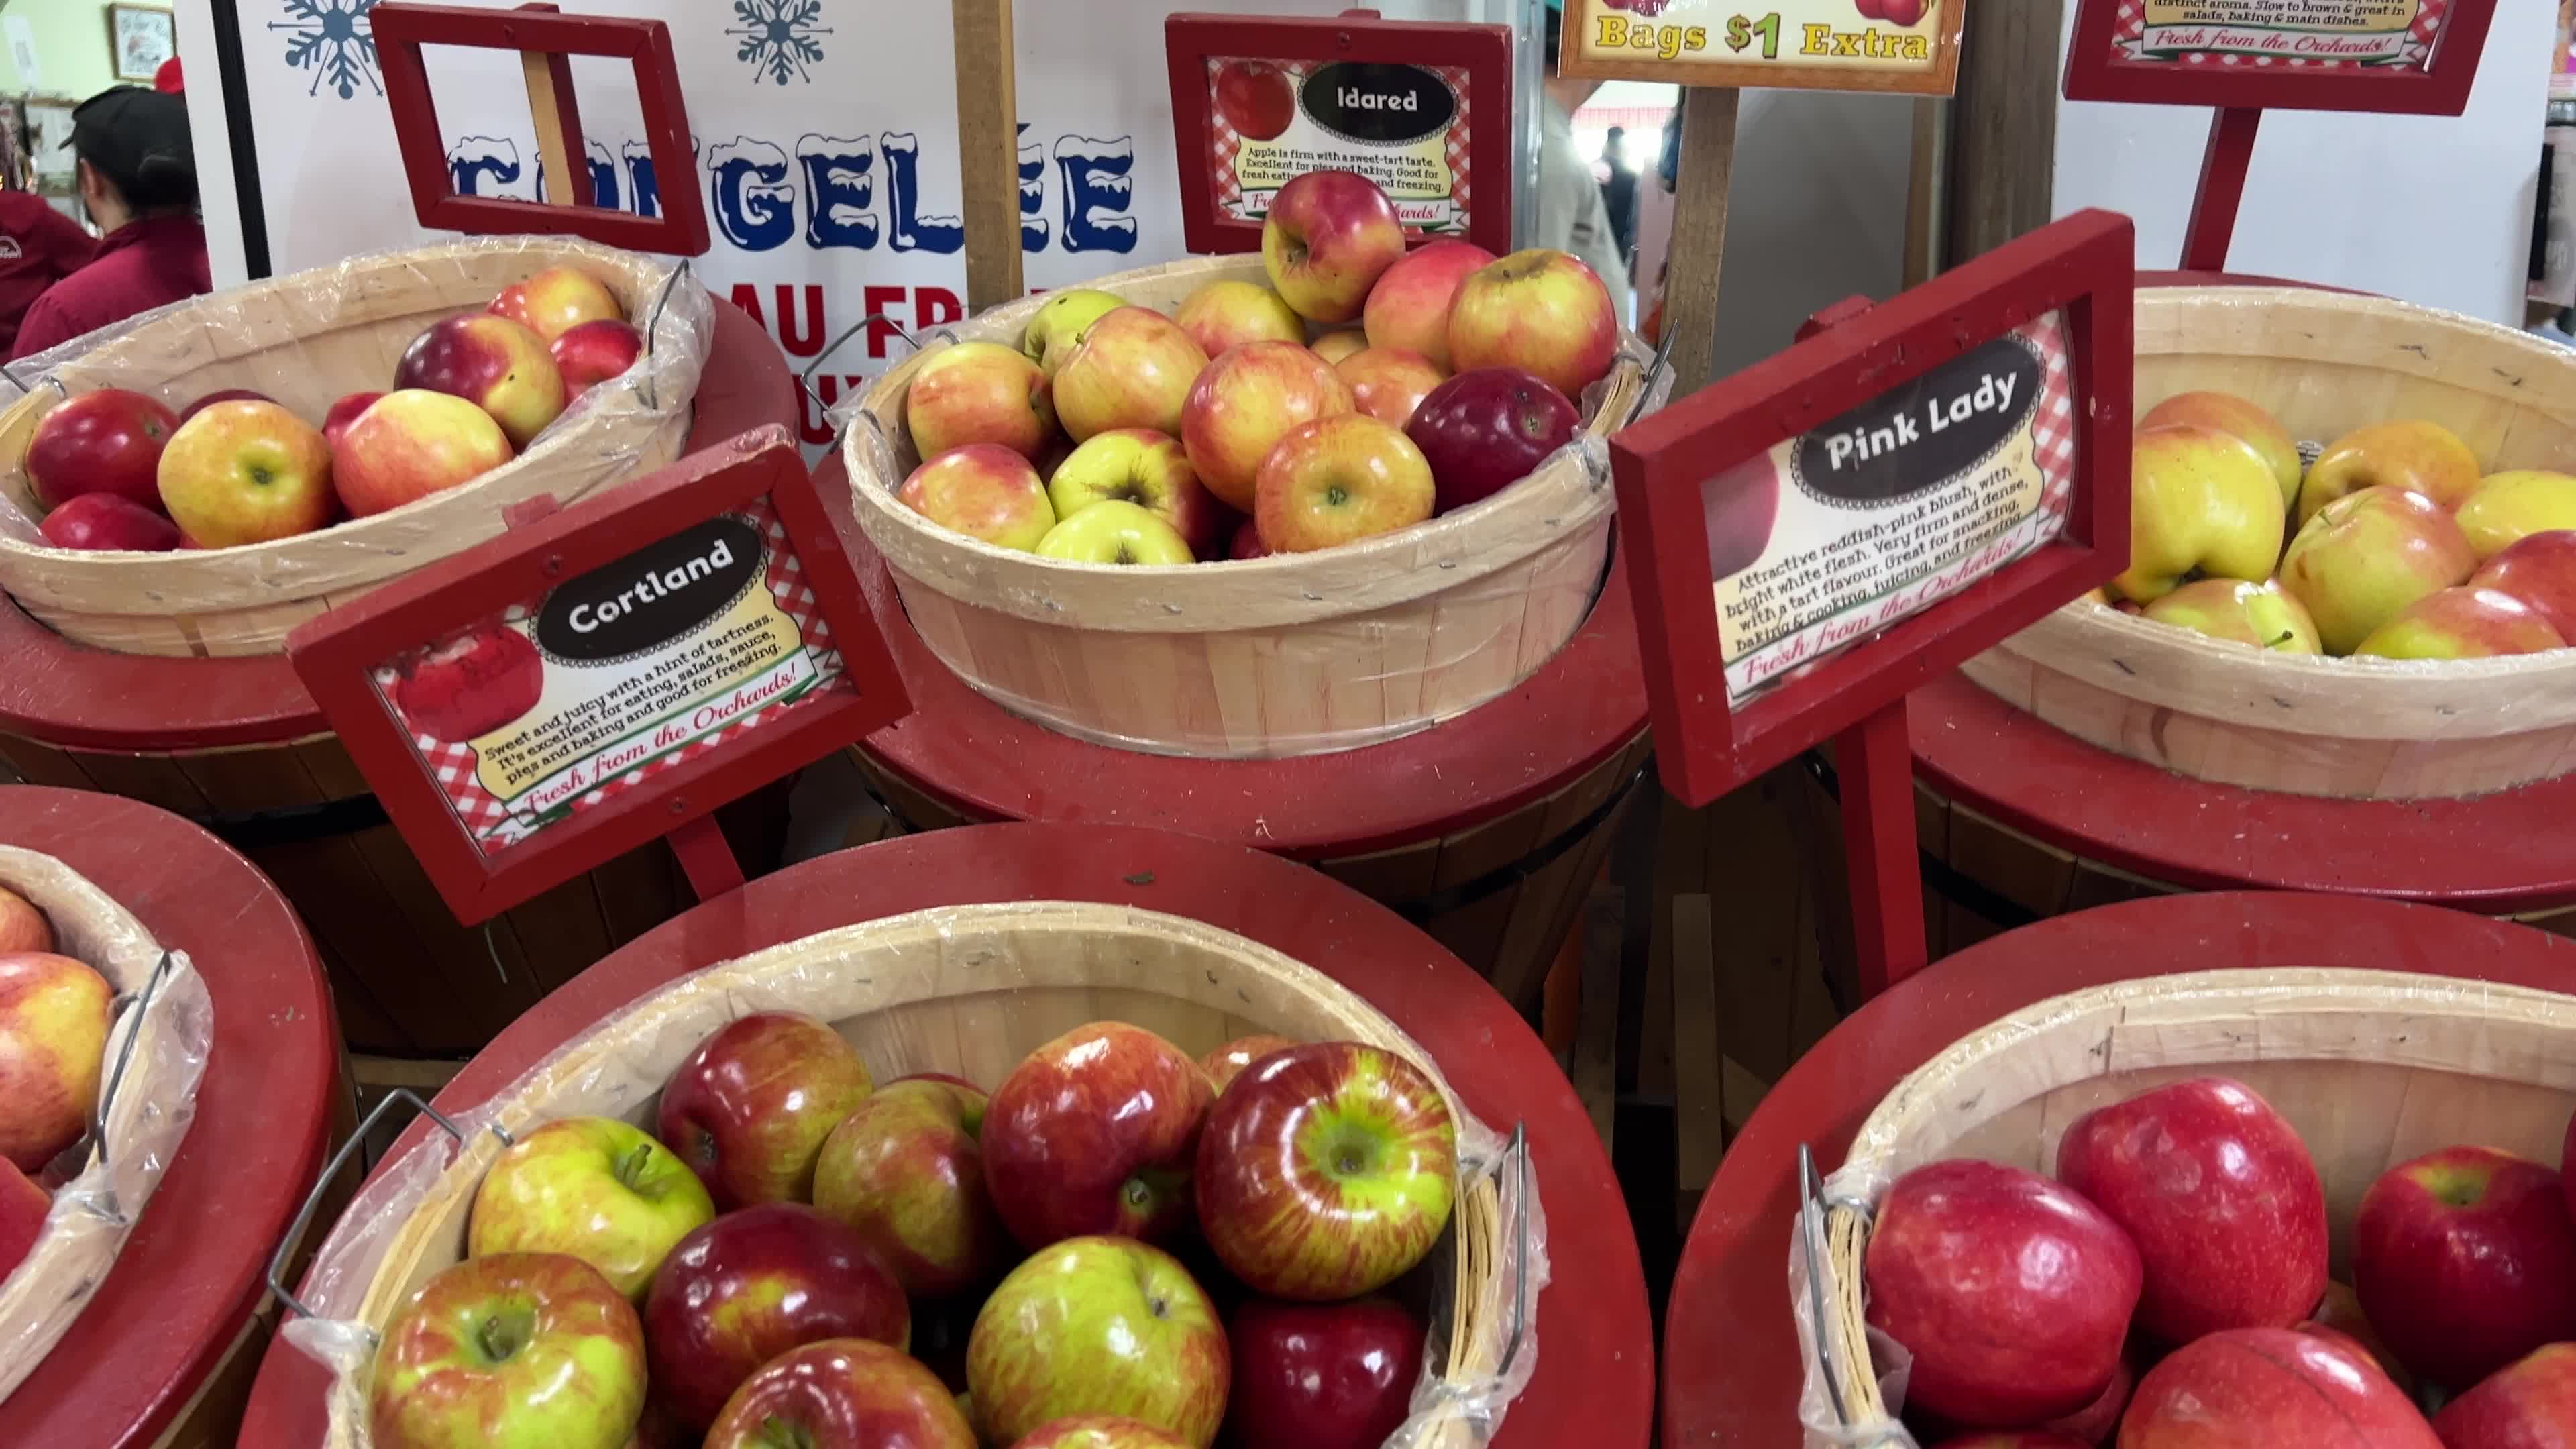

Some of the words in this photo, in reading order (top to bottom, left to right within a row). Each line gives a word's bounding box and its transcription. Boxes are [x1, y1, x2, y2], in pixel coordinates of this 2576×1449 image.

[1595, 15, 1707, 60] Bags
[1725, 13, 1781, 59] $1
[1799, 23, 1928, 60] Extra
[2155, 28, 2205, 46] Fresh
[2203, 29, 2255, 49] from
[2261, 33, 2288, 49] the
[2294, 36, 2392, 52] Orchards!
[2183, 10, 2224, 23] salads,
[2229, 11, 2273, 24] baking
[2274, 13, 2283, 22] &
[2286, 14, 2320, 24] main
[2323, 15, 2369, 26] dishes.
[2210, 0, 2252, 9] aroma.
[2255, 1, 2285, 11] Slow
[2288, 2, 2299, 11] to
[2302, 2, 2341, 13] brown
[2343, 5, 2351, 13] &
[2355, 6, 2388, 16] great
[2391, 7, 2406, 16] in
[1337, 86, 1417, 111] Idared
[1242, 169, 1270, 180] fresh
[1271, 171, 1297, 181] eati
[1397, 180, 1444, 193] freezing.
[1246, 158, 1293, 169] Excellent
[1296, 161, 1309, 172] for
[1397, 168, 1421, 178] Good
[1425, 170, 1438, 179] for
[1248, 147, 1275, 158] Apple
[1279, 148, 1288, 158] is
[1291, 149, 1314, 160] firm
[1317, 152, 1340, 161] with
[1350, 154, 1403, 165] sweet-tart
[1406, 156, 1436, 167] taste.
[1825, 412, 1919, 470] Pink
[1929, 371, 2017, 433] Lady
[1725, 586, 1776, 619] bright
[1778, 570, 1821, 595] white
[1825, 550, 1871, 572] flesh.
[1874, 532, 1911, 553] Very
[1915, 515, 1949, 538] firm
[1952, 503, 1979, 521] and
[1739, 550, 1817, 594] Attractive
[1821, 504, 1927, 557] reddish-pink
[1929, 486, 1976, 513] blush,
[1979, 466, 2012, 490] with
[568, 539, 735, 633] Cortland
[1736, 623, 1790, 653] baking
[1793, 615, 1805, 629] &
[1934, 545, 1960, 564] and
[1739, 607, 1776, 631] with
[1780, 604, 1787, 614] a
[1789, 587, 1820, 607] tart
[1823, 566, 1882, 596] flavour.
[1885, 544, 1926, 568] Great
[1929, 530, 1950, 551] for
[1744, 633, 1809, 682] Fresh
[1811, 615, 1873, 657] from
[1880, 592, 1911, 620] the
[1919, 527, 2022, 599] Orchards!
[484, 731, 532, 762] Sweet
[533, 714, 563, 738] and
[564, 695, 606, 727] juicy
[606, 676, 644, 700] with
[645, 672, 653, 682] a
[653, 653, 690, 677] hint
[692, 643, 706, 659] of
[706, 614, 774, 650] tartness.
[496, 753, 525, 771] It's
[527, 714, 598, 755] excellent
[601, 704, 623, 720] for
[625, 678, 678, 708] eating,
[678, 653, 730, 682] salads,
[730, 631, 776, 655] sauce,
[506, 761, 539, 786] pies
[542, 746, 570, 765] and
[571, 720, 625, 751] baking
[627, 705, 655, 723] and
[656, 684, 690, 710] good
[692, 675, 713, 691] for
[716, 643, 782, 678] freezing.
[524, 767, 586, 814] Fresh
[591, 743, 648, 785] from
[654, 724, 687, 752] the
[694, 662, 796, 730] Orchards!
